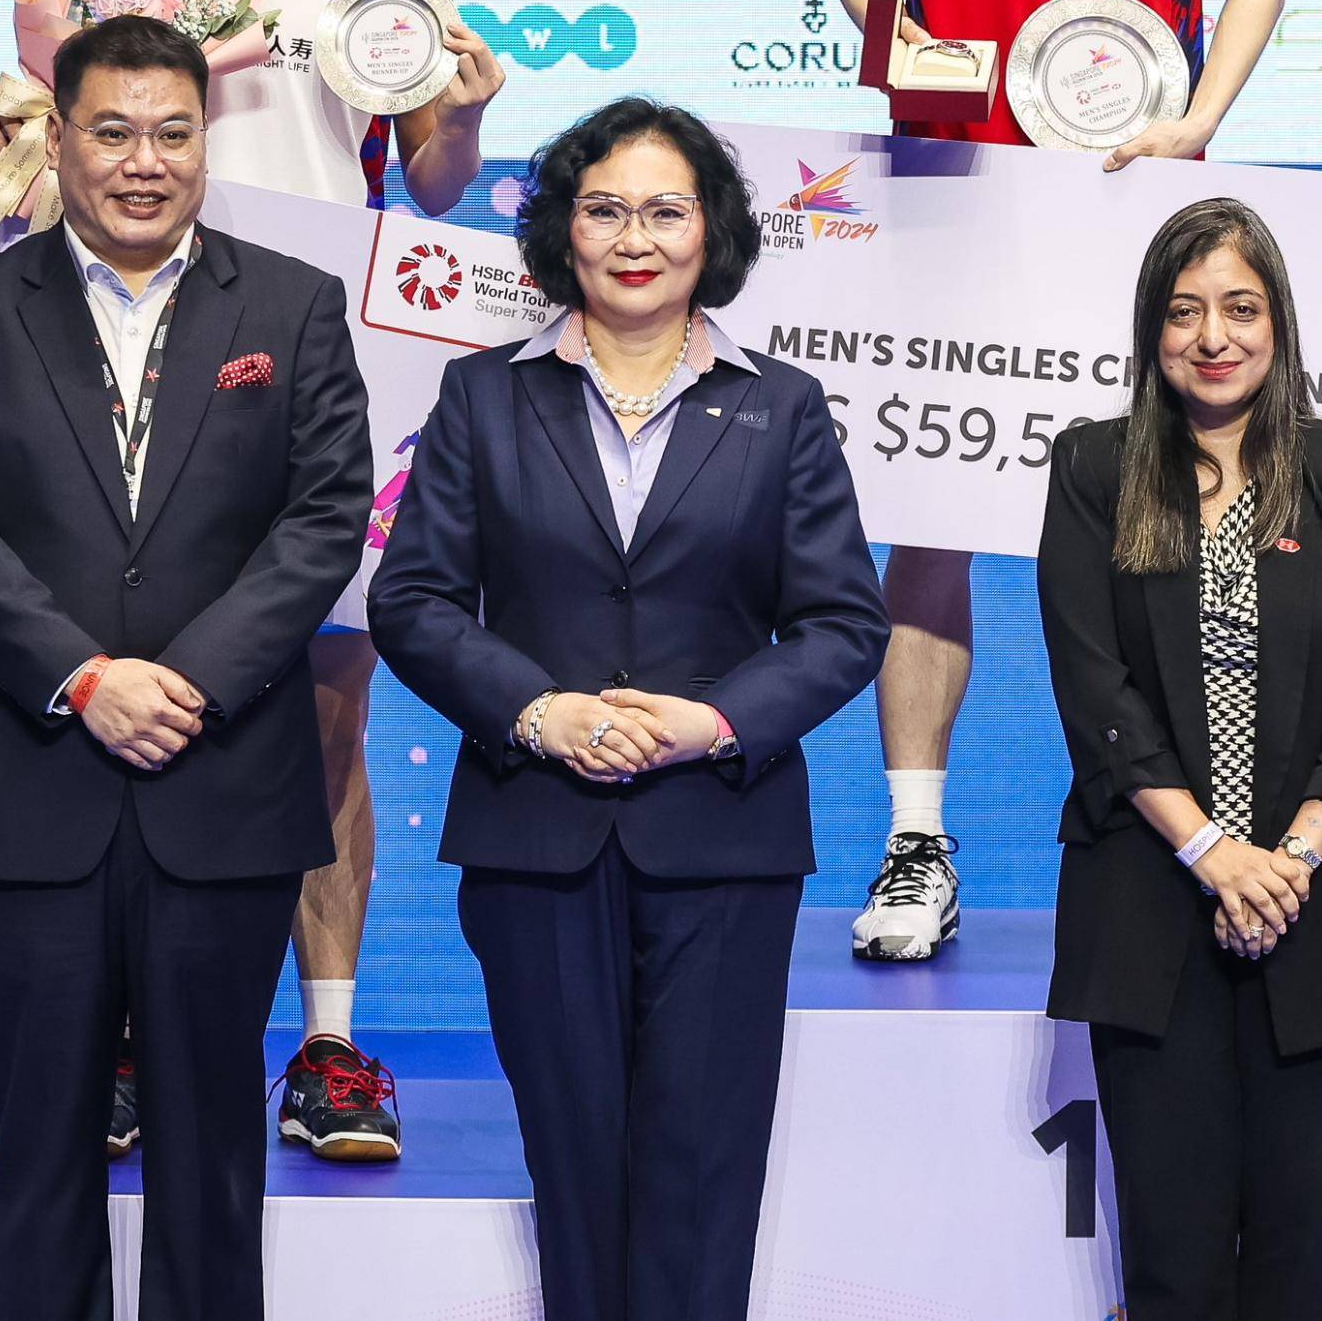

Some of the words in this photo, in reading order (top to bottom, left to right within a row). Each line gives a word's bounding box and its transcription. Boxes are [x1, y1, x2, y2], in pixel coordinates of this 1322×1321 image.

[288, 61, 310, 73] LIFE
[0, 90, 24, 107] Today
[773, 235, 804, 249] OPEN
[824, 220, 879, 243] 2024
[472, 264, 515, 284] HSBC
[474, 282, 519, 302] World
[520, 290, 551, 308] Tour
[474, 299, 517, 318] Super
[521, 308, 546, 324] 750
[767, 325, 895, 366] MEN'S
[905, 337, 1080, 382] SINGLES
[873, 393, 1096, 472] $59,5
[1031, 1099, 1096, 1238] 1
